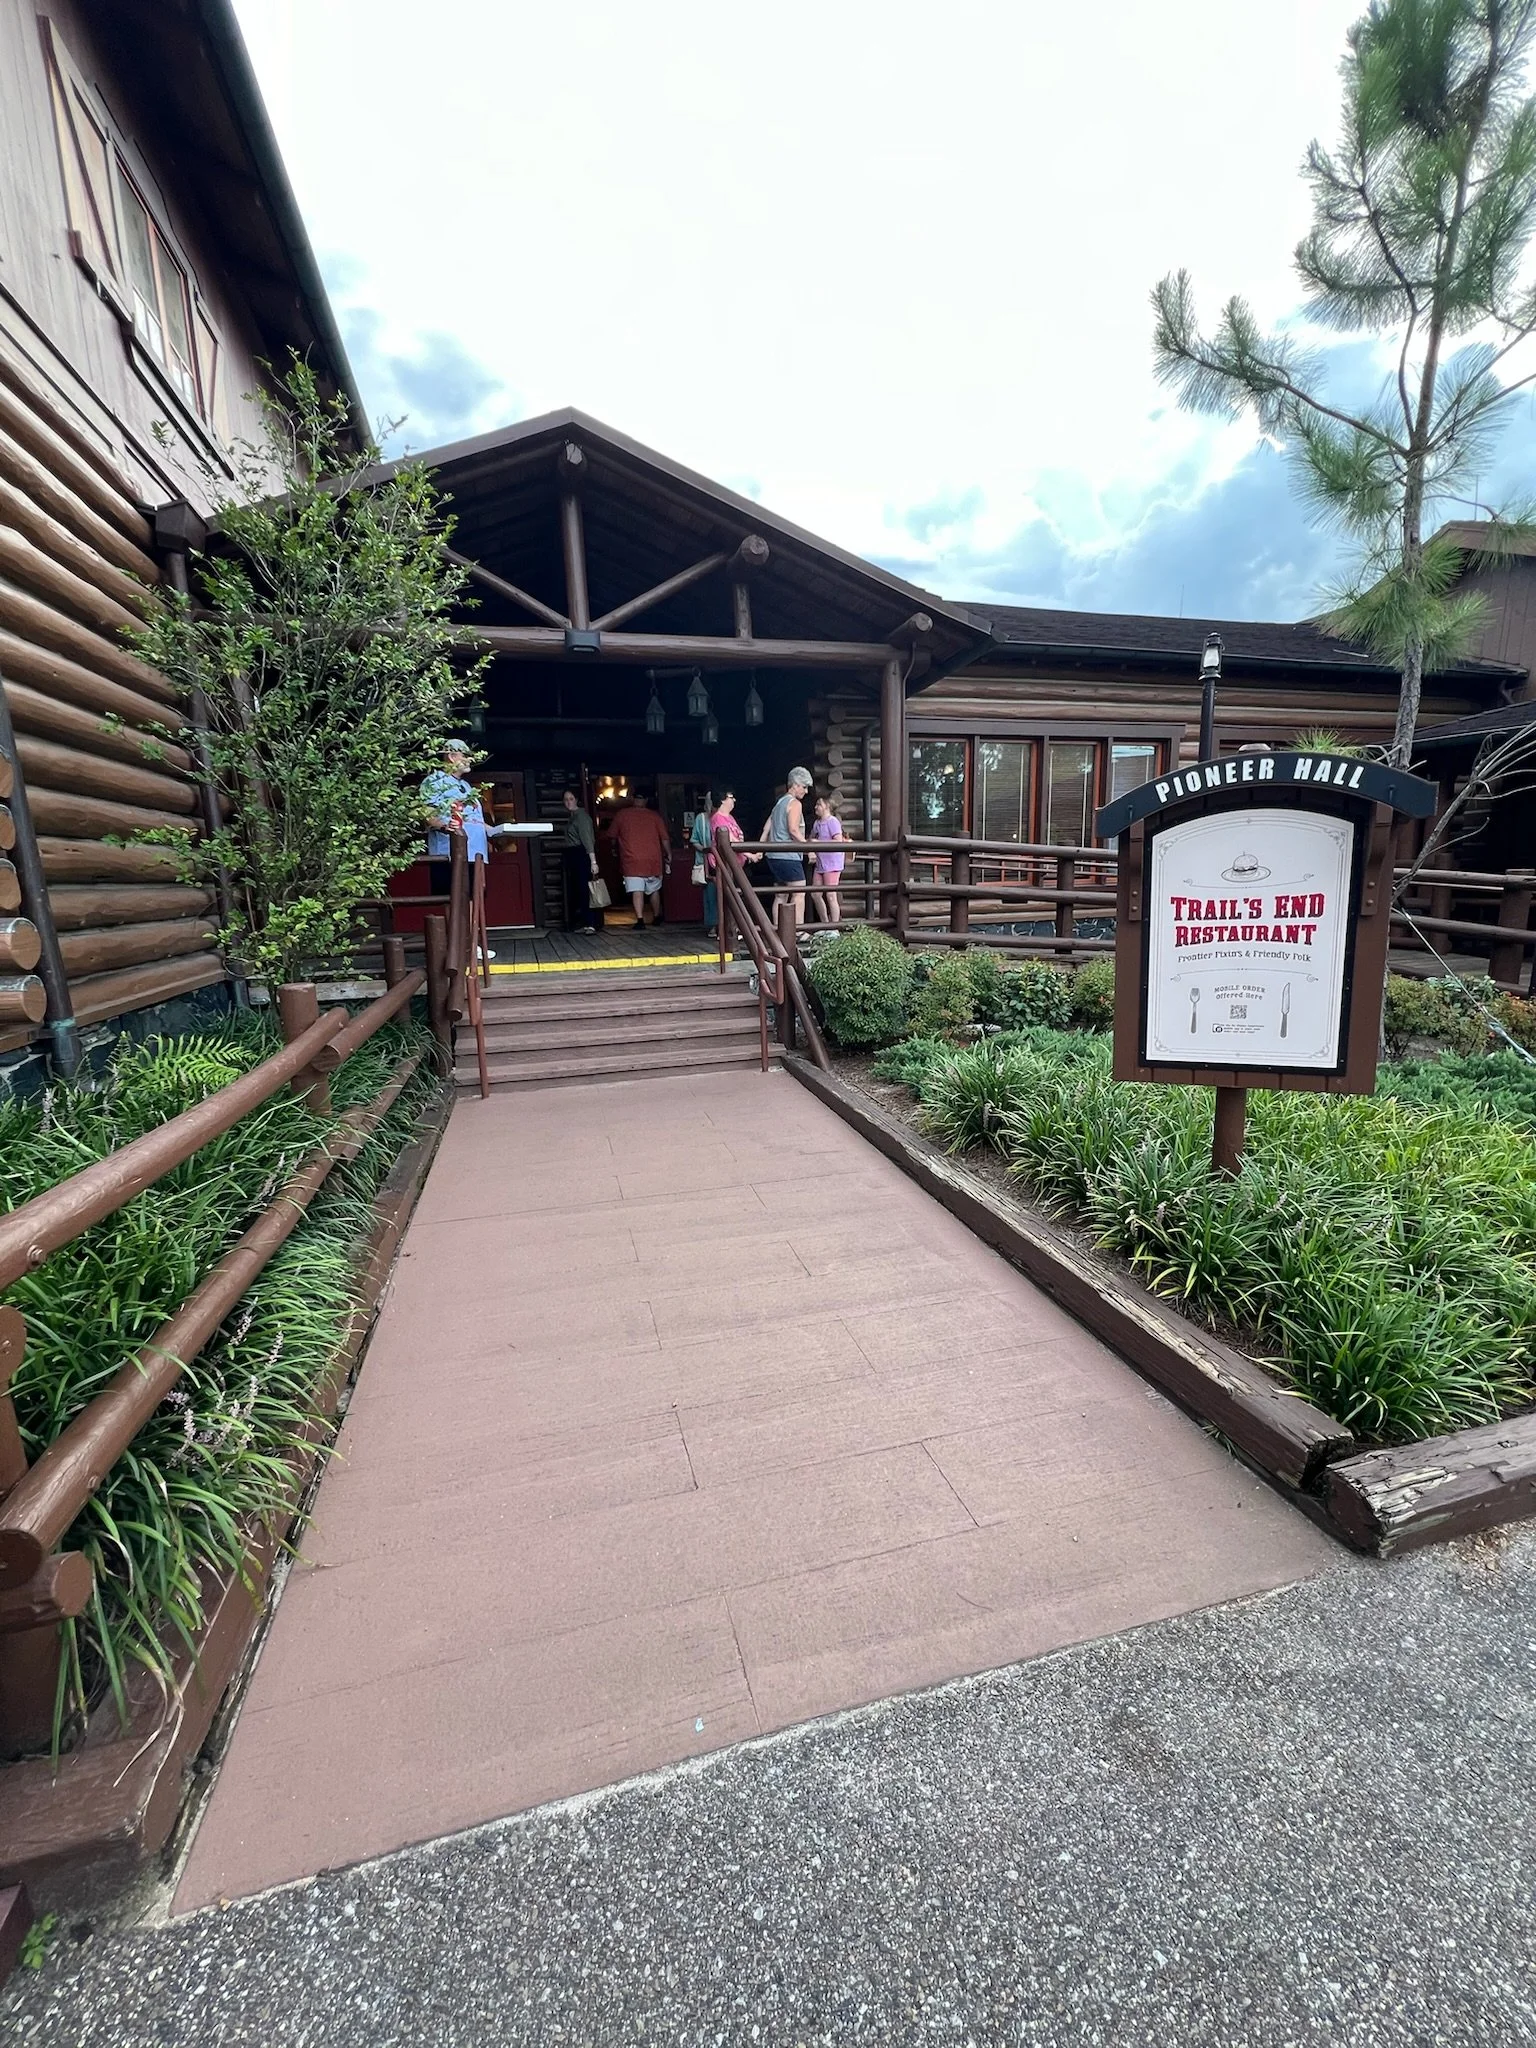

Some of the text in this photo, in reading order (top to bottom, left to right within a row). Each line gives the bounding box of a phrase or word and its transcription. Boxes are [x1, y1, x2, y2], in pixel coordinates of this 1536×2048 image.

[1155, 758, 1364, 803] PIONEER HALL
[1170, 893, 1325, 921] TRAIL'S END
[1175, 924, 1317, 947] RESTAURANT
[1177, 952, 1213, 963] Frontier
[1253, 950, 1291, 961] Friendly
[1293, 952, 1312, 963] Folk
[1242, 985, 1266, 993] ORDER
